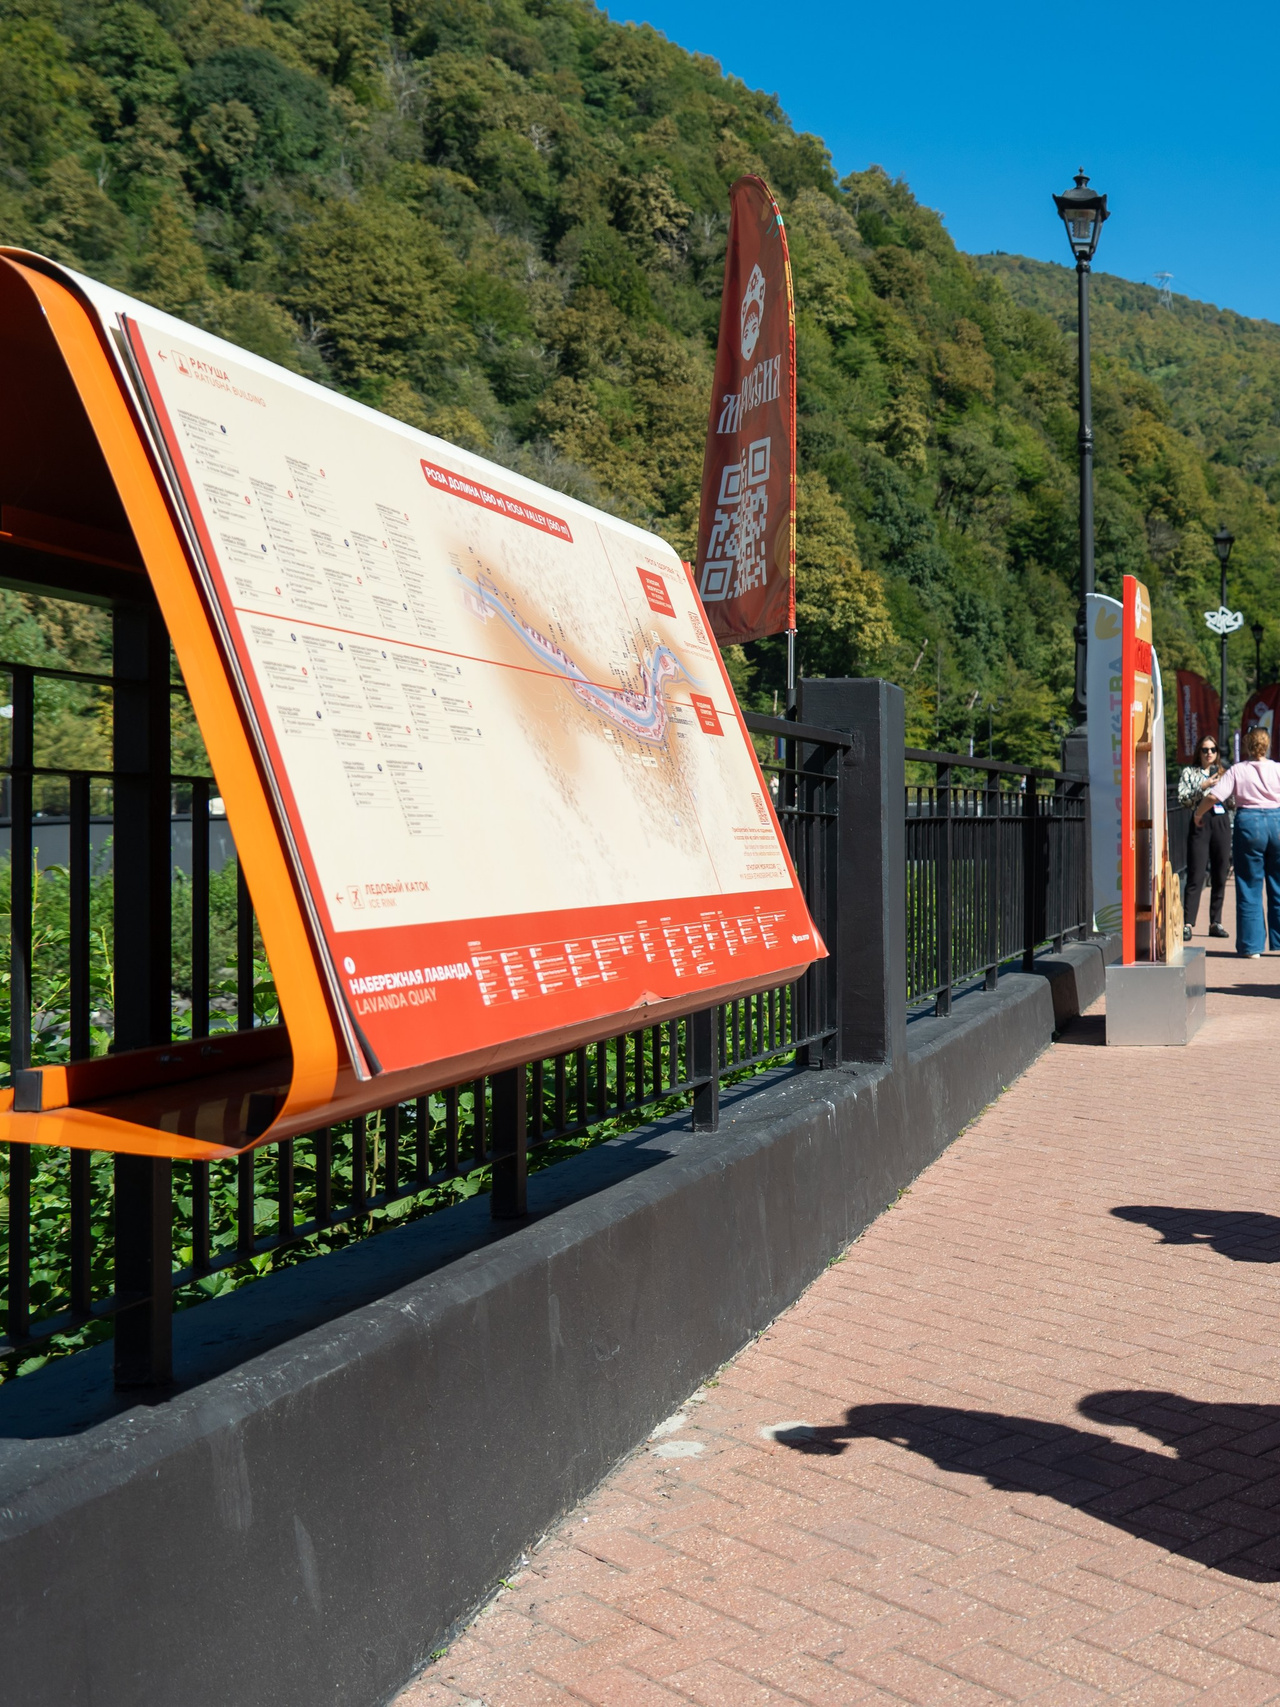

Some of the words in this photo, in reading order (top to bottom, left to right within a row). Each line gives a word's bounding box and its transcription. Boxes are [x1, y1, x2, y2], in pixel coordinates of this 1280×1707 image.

[189, 357, 231, 382] РАТУША
[424, 466, 448, 486] РОЗА
[447, 476, 481, 499] ДОЛИНА
[506, 501, 525, 517] ROSA
[523, 508, 547, 526] VALLEY
[365, 879, 403, 896] ЛЕДОВЫЙ
[405, 881, 431, 892] КАТОК
[369, 899, 381, 909] ICE
[381, 898, 397, 908] RINK
[349, 968, 424, 996] НАБЕРЕЖНАЯ
[424, 962, 473, 984] ЛАВАНДА
[355, 992, 408, 1016] LAVANDA
[407, 986, 438, 1007] QUAY
